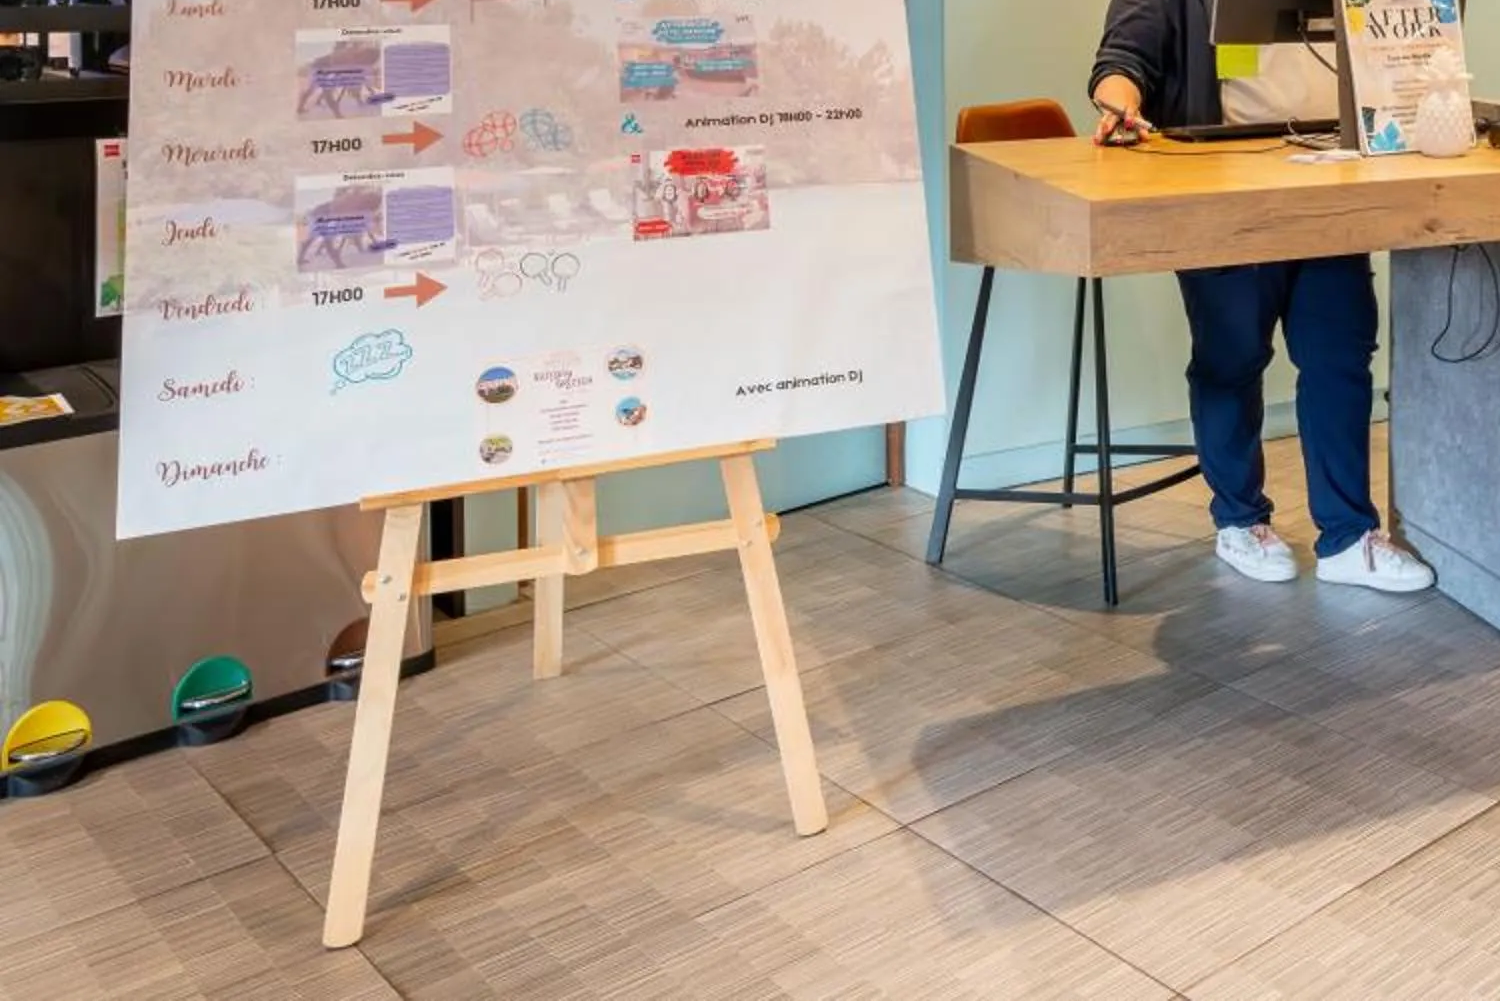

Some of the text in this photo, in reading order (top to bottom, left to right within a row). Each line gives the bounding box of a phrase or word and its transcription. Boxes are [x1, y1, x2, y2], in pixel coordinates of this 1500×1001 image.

[1367, 6, 1441, 27] AFTER
[1366, 23, 1442, 40] WORK
[163, 66, 240, 93] Mardi
[685, 112, 757, 128] Animation
[312, 137, 362, 154] 17H00
[161, 216, 219, 246] Jeudi
[158, 288, 254, 321] Vendredi
[311, 286, 363, 307] 17H00
[157, 370, 244, 402] Samedi
[736, 381, 773, 396] Avec
[775, 372, 846, 390] animation
[156, 449, 270, 487] Dimanche
